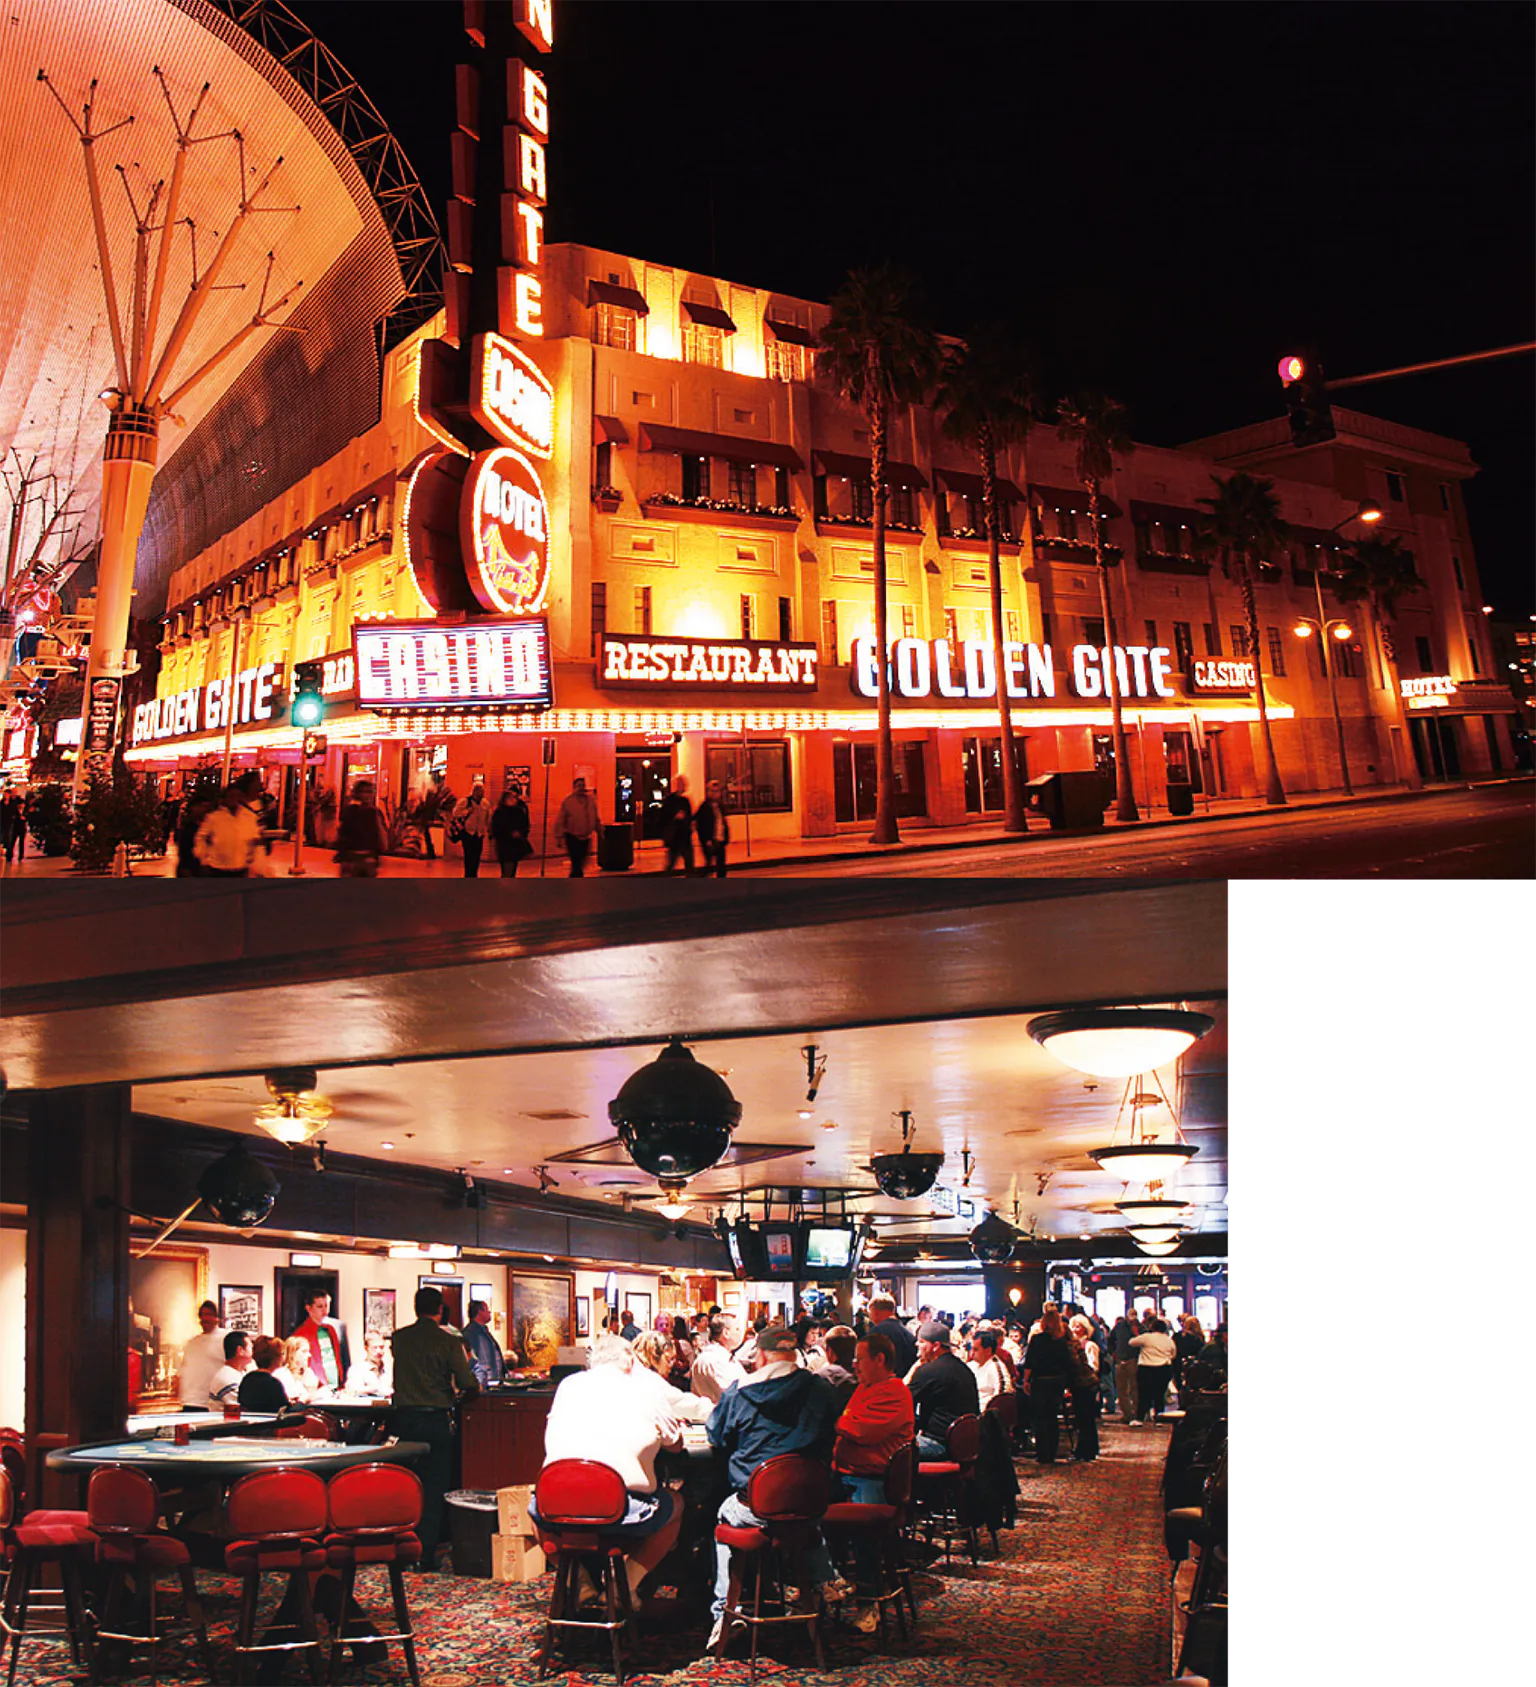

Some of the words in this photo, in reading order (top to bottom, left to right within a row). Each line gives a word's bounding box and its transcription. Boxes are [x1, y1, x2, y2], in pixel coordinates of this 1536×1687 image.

[516, 67, 548, 336] GATE
[604, 641, 818, 684] RESTAURANT
[856, 637, 1056, 698] GOLDEN
[1073, 644, 1175, 697] GATE
[1194, 661, 1257, 687] CASINO
[133, 686, 201, 742] GOLDEN
[205, 662, 275, 729] GATE
